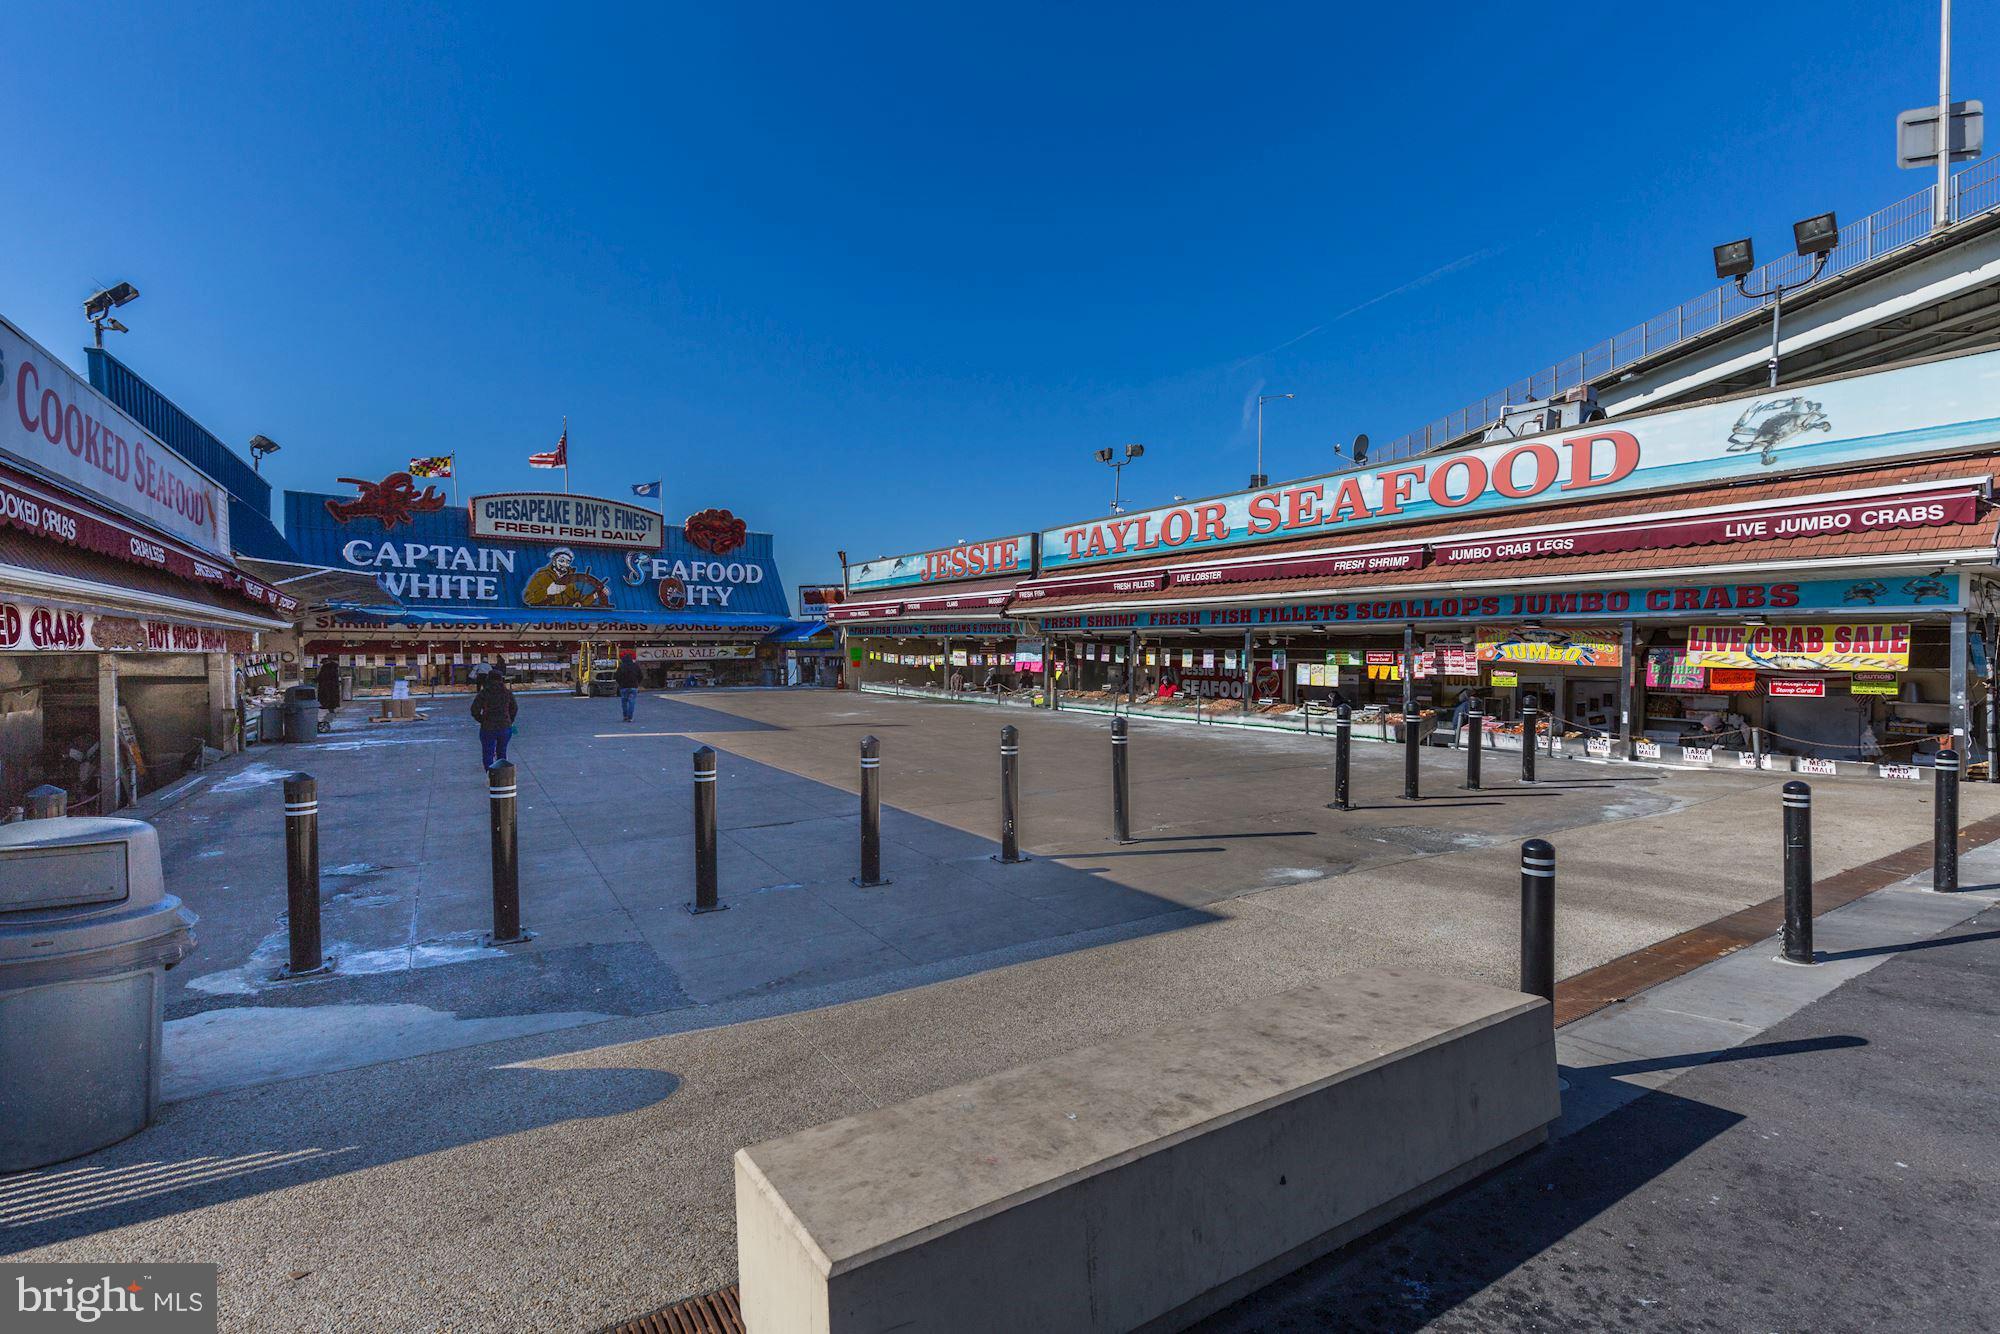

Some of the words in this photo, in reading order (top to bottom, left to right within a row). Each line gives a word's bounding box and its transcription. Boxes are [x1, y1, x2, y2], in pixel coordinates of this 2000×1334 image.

[17, 361, 130, 482] COOKED
[134, 442, 204, 526] SEAFOOD
[1064, 502, 1231, 560] TAYLOR
[1247, 430, 1641, 536] SEAFOOD
[485, 499, 570, 526] CHESAPEAKE
[575, 501, 610, 528] BAY'S
[614, 508, 654, 532] FINEST
[1725, 521, 1767, 538] LIVE
[1774, 512, 1851, 534] JUMBO
[1860, 504, 1944, 526] CRABS
[494, 521, 554, 535] FRESH
[559, 526, 596, 539] FISH
[601, 530, 647, 542] DAILY
[343, 540, 516, 574] CAPTAIN
[920, 538, 1019, 582] JESSIE
[1333, 558, 1365, 571] FRESH
[1368, 555, 1410, 569] SHRIMP
[1448, 545, 1492, 561] JUMBO
[1496, 541, 1531, 556] CRAB
[1536, 538, 1575, 552] LEGS
[622, 550, 764, 587] SEAFOOD
[1176, 573, 1191, 583] LIVE
[1191, 571, 1222, 582] LOBSTER
[376, 571, 499, 601] WHITE
[1018, 591, 1033, 599] FRESH
[1034, 589, 1046, 598] FISH
[1113, 582, 1131, 590] FRESH
[1132, 580, 1155, 590] FILLETS
[1044, 616, 1082, 628] FRESH
[1087, 614, 1138, 627] SHRIMP
[1150, 611, 1201, 626] FRESH
[1210, 609, 1252, 624] FISH
[1259, 603, 1349, 623] FILLETS
[1356, 596, 1499, 620] SCALLOPS
[1511, 589, 1629, 616] JUMBO
[1646, 583, 1800, 611] CRABS
[30, 606, 85, 650] CRABS
[147, 622, 170, 649] HOT
[1689, 626, 1746, 652] LIVE
[1754, 625, 1825, 653] CRAB
[1834, 625, 1909, 654] SALE
[653, 649, 684, 659] CRAB
[689, 648, 715, 658] SALE
[1802, 765, 1834, 773] FEMALE
[1809, 759, 1827, 767] MED
